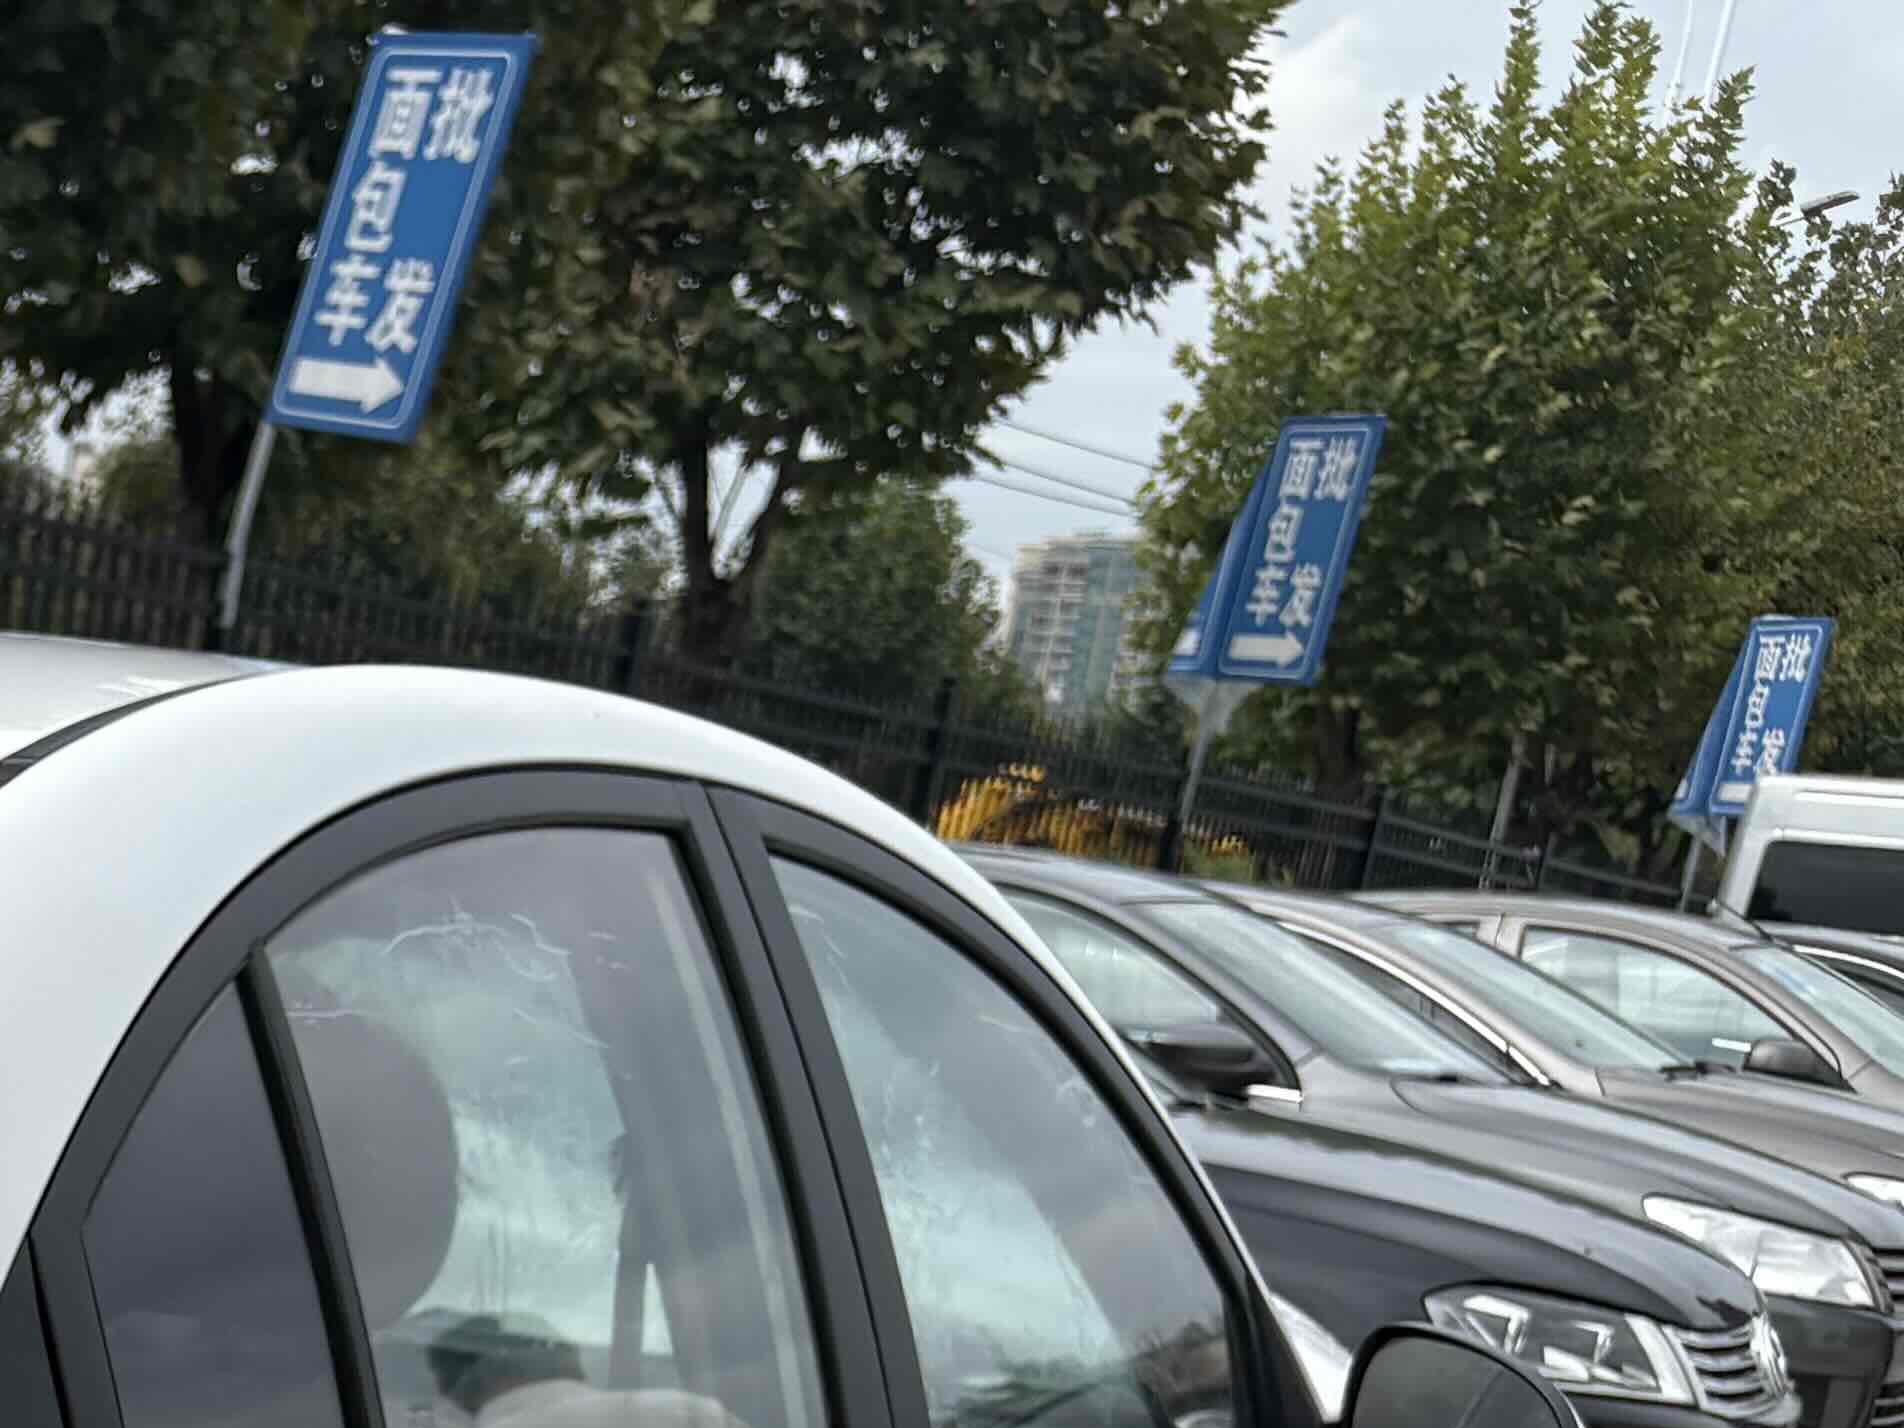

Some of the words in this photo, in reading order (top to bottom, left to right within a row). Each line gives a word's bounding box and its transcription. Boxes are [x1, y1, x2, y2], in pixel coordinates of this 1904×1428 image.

[314, 67, 442, 347] 面包车
[364, 66, 495, 353] 批发
[1246, 437, 1324, 626] 面包车
